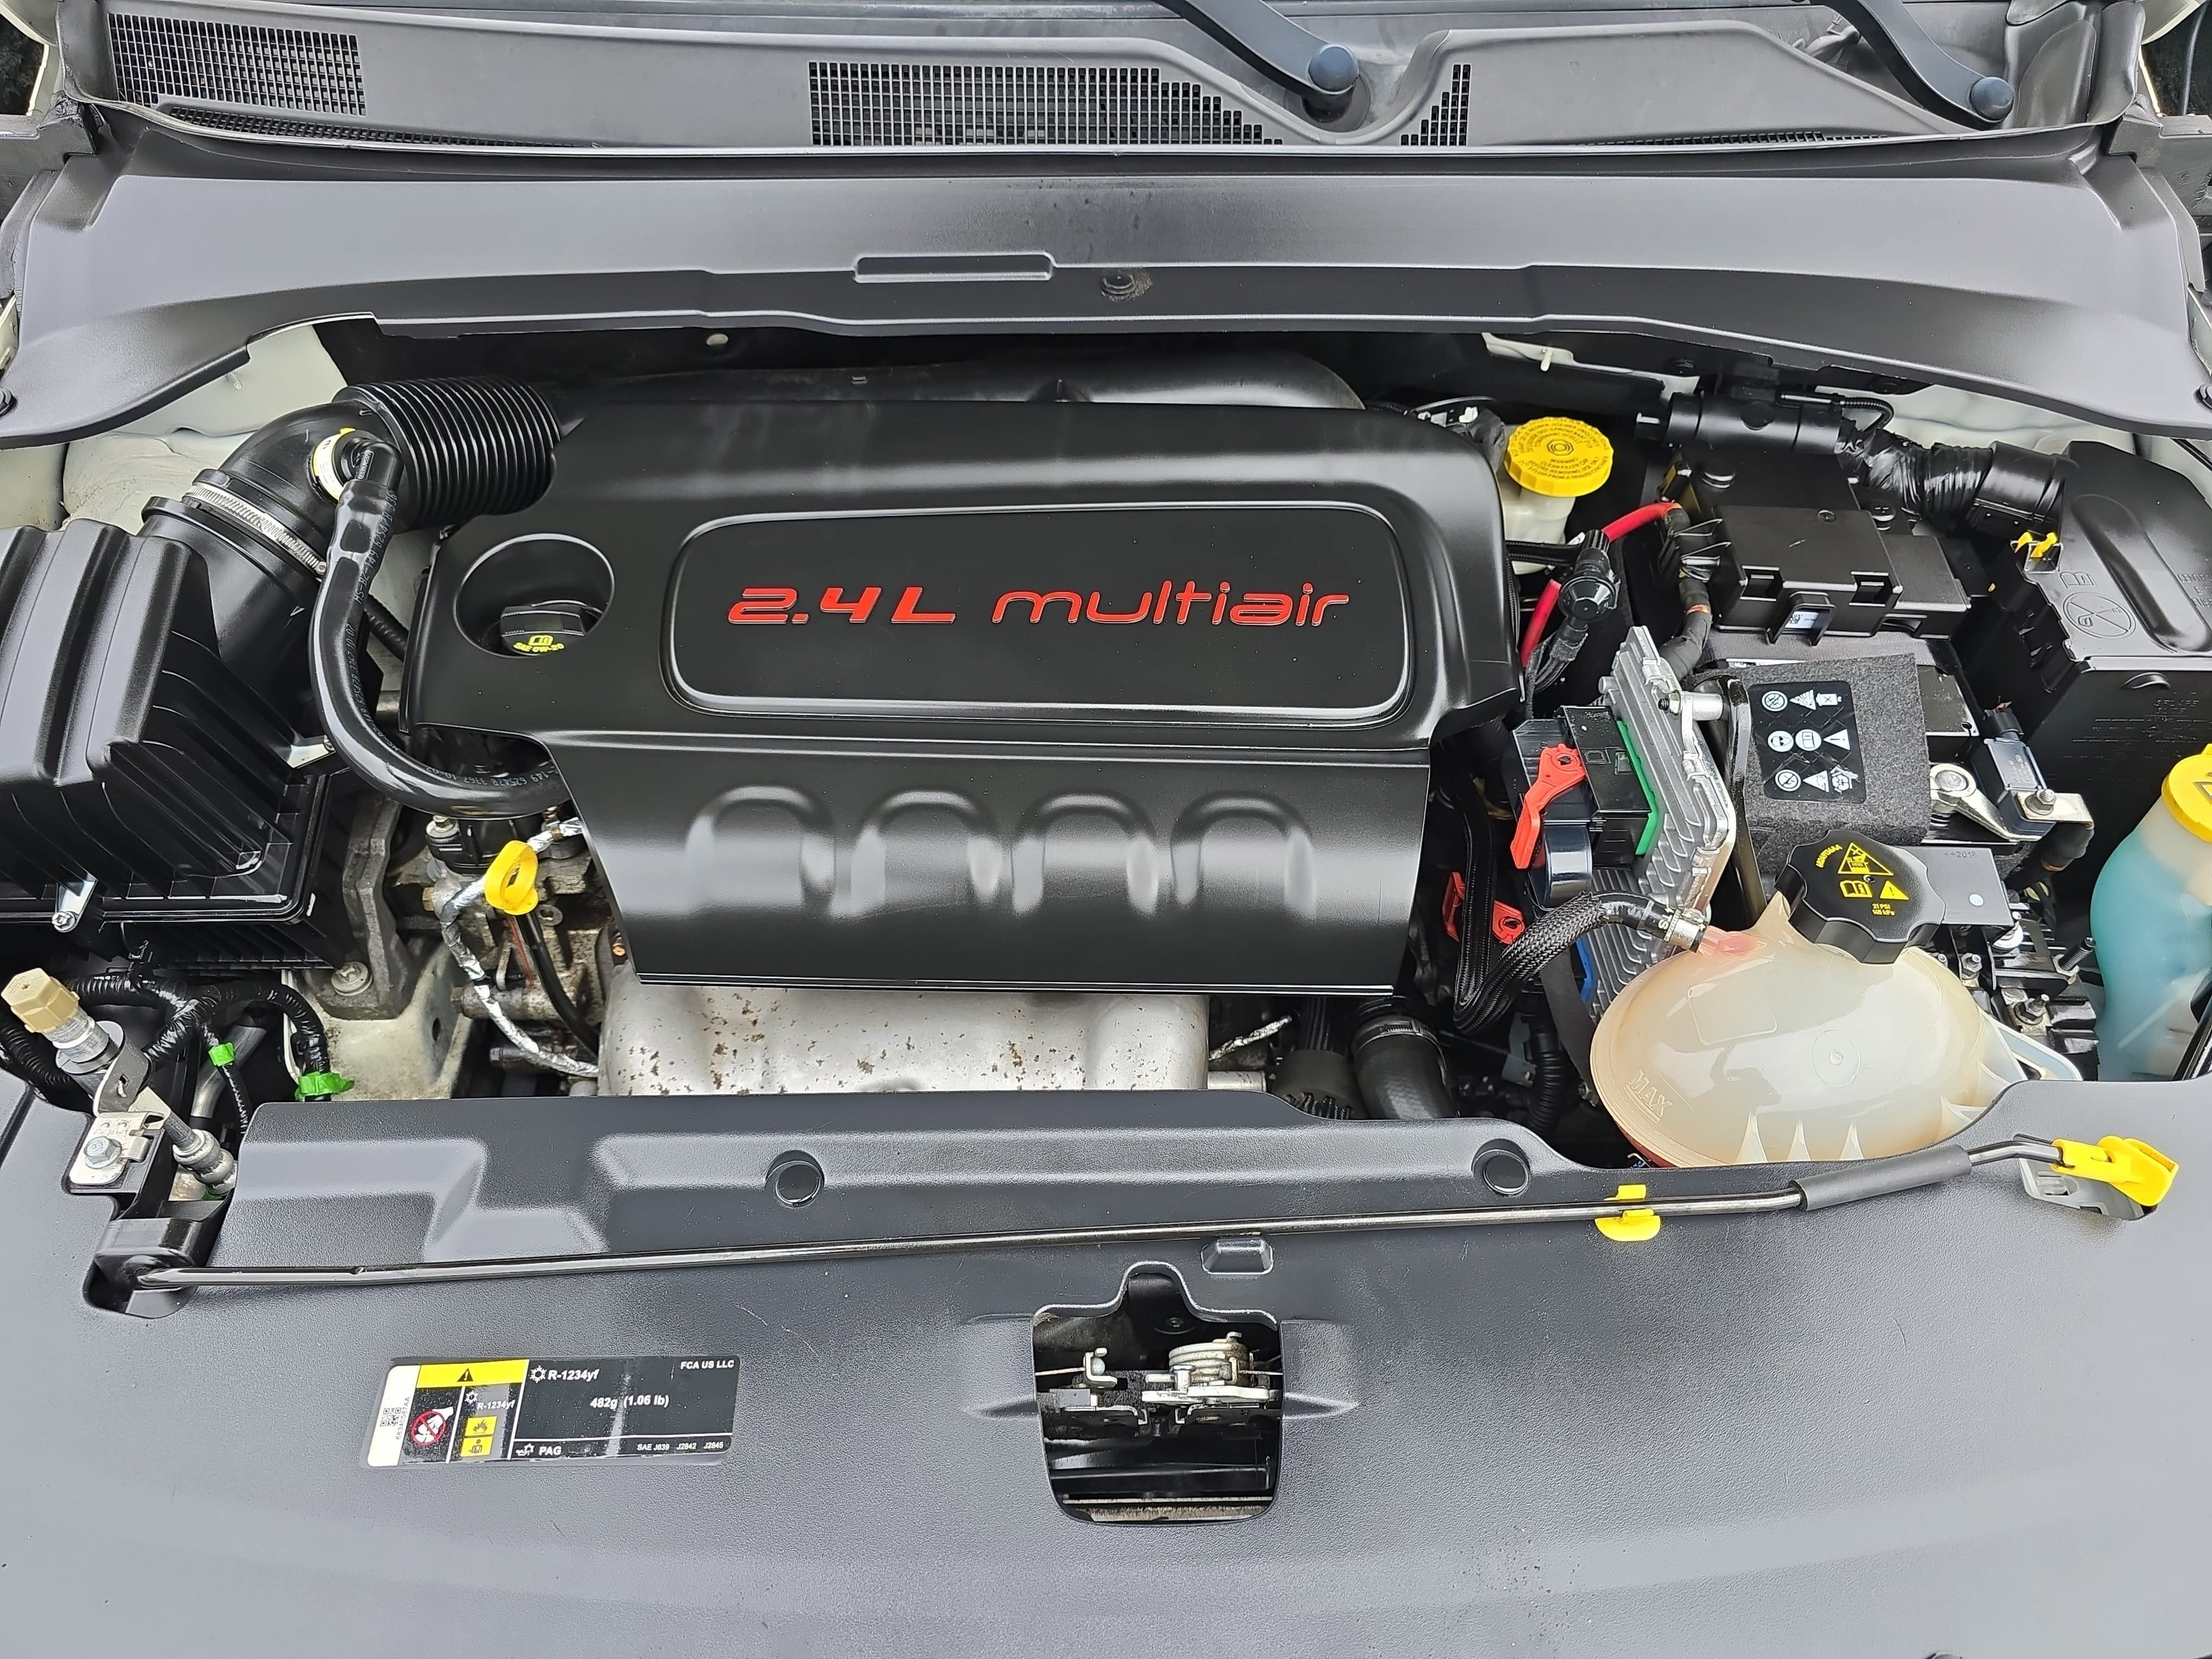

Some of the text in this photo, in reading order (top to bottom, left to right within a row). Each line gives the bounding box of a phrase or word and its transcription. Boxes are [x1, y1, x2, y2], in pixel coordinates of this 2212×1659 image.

[992, 580, 1349, 627] multiair
[1628, 1069, 1673, 1117] MAX
[680, 1360, 735, 1370] FCA US LLC
[548, 1369, 600, 1382] R-1234yf
[477, 1399, 516, 1410] R-1234yf
[589, 1394, 670, 1410] 482g (1.06 lb)
[538, 1445, 562, 1455] PAG
[677, 1442, 697, 1450] J2842
